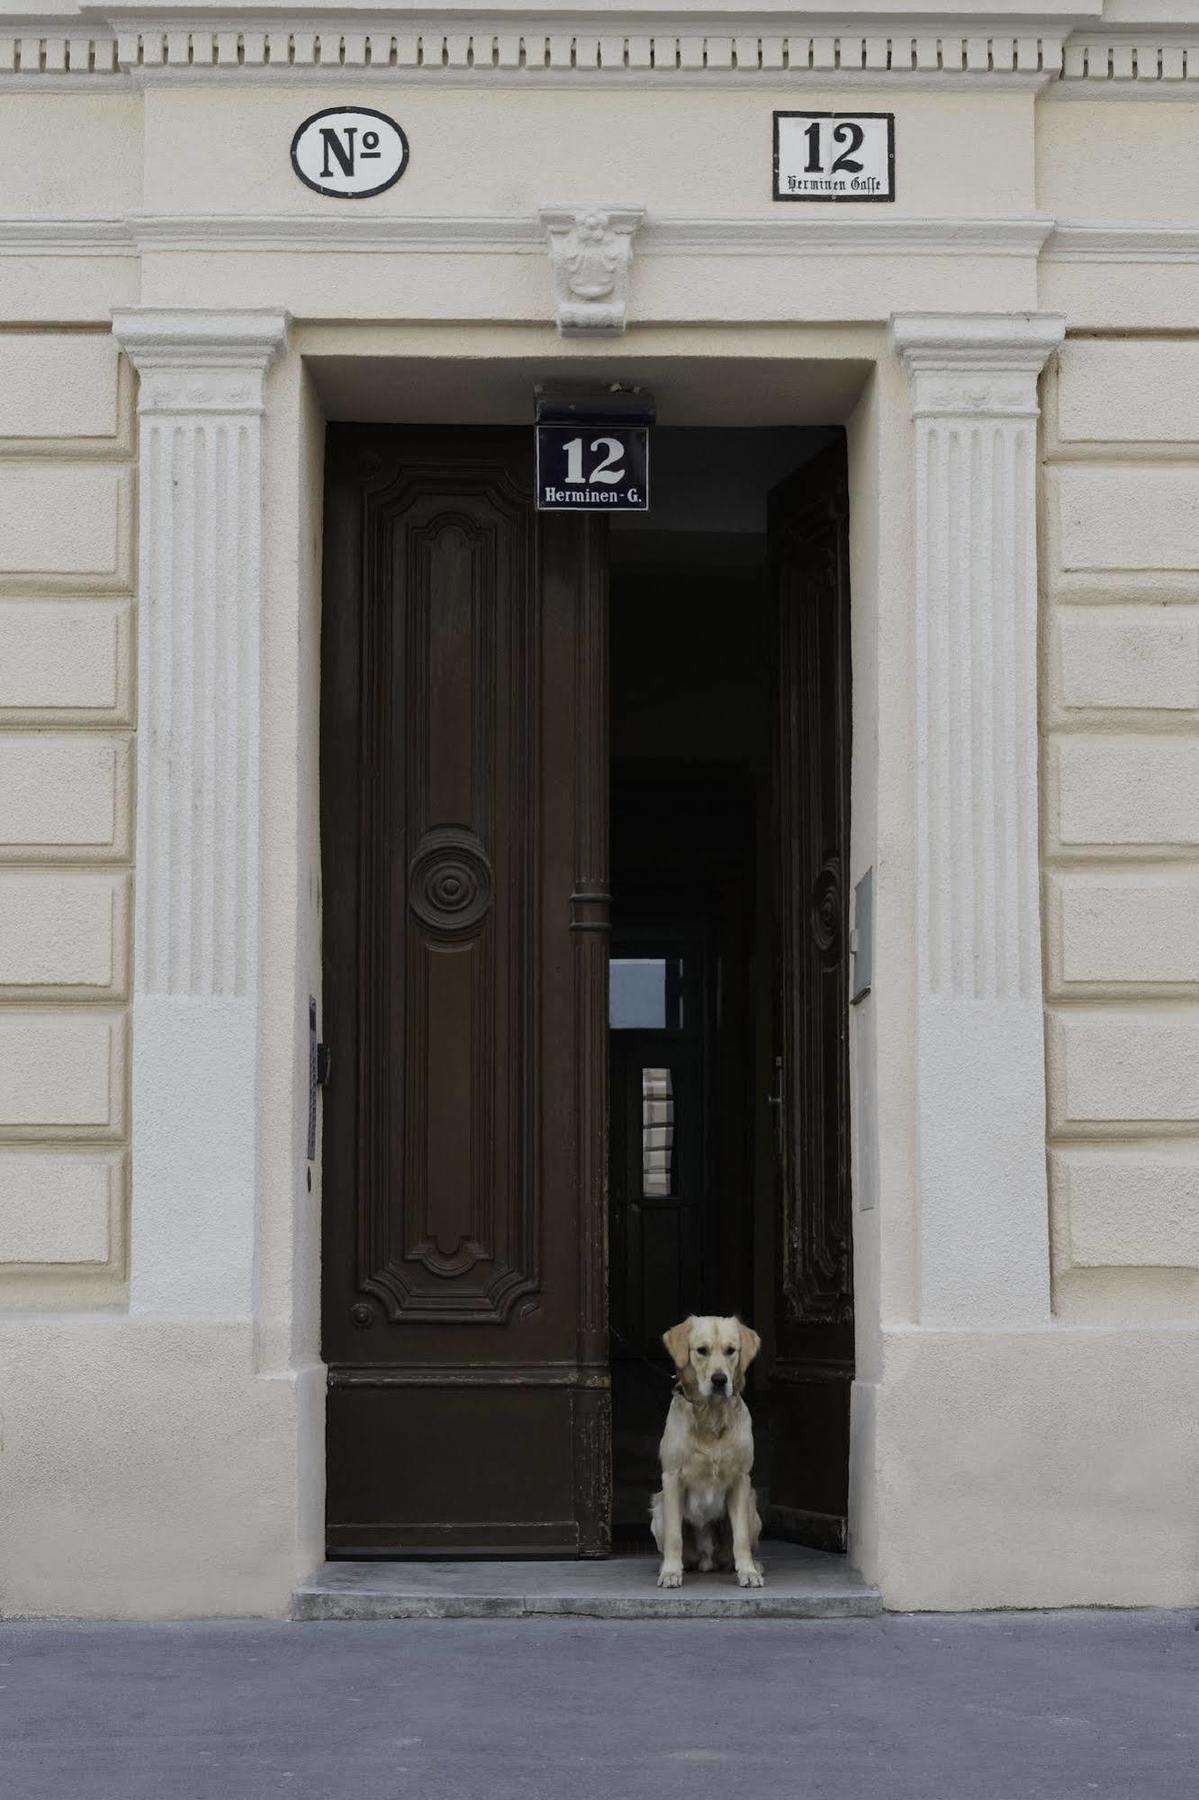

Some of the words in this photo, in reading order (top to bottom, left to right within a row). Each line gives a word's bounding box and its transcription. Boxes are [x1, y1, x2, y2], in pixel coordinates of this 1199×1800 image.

[804, 122, 864, 174] 12
[787, 175, 846, 192] Herminen
[562, 437, 625, 484] 12
